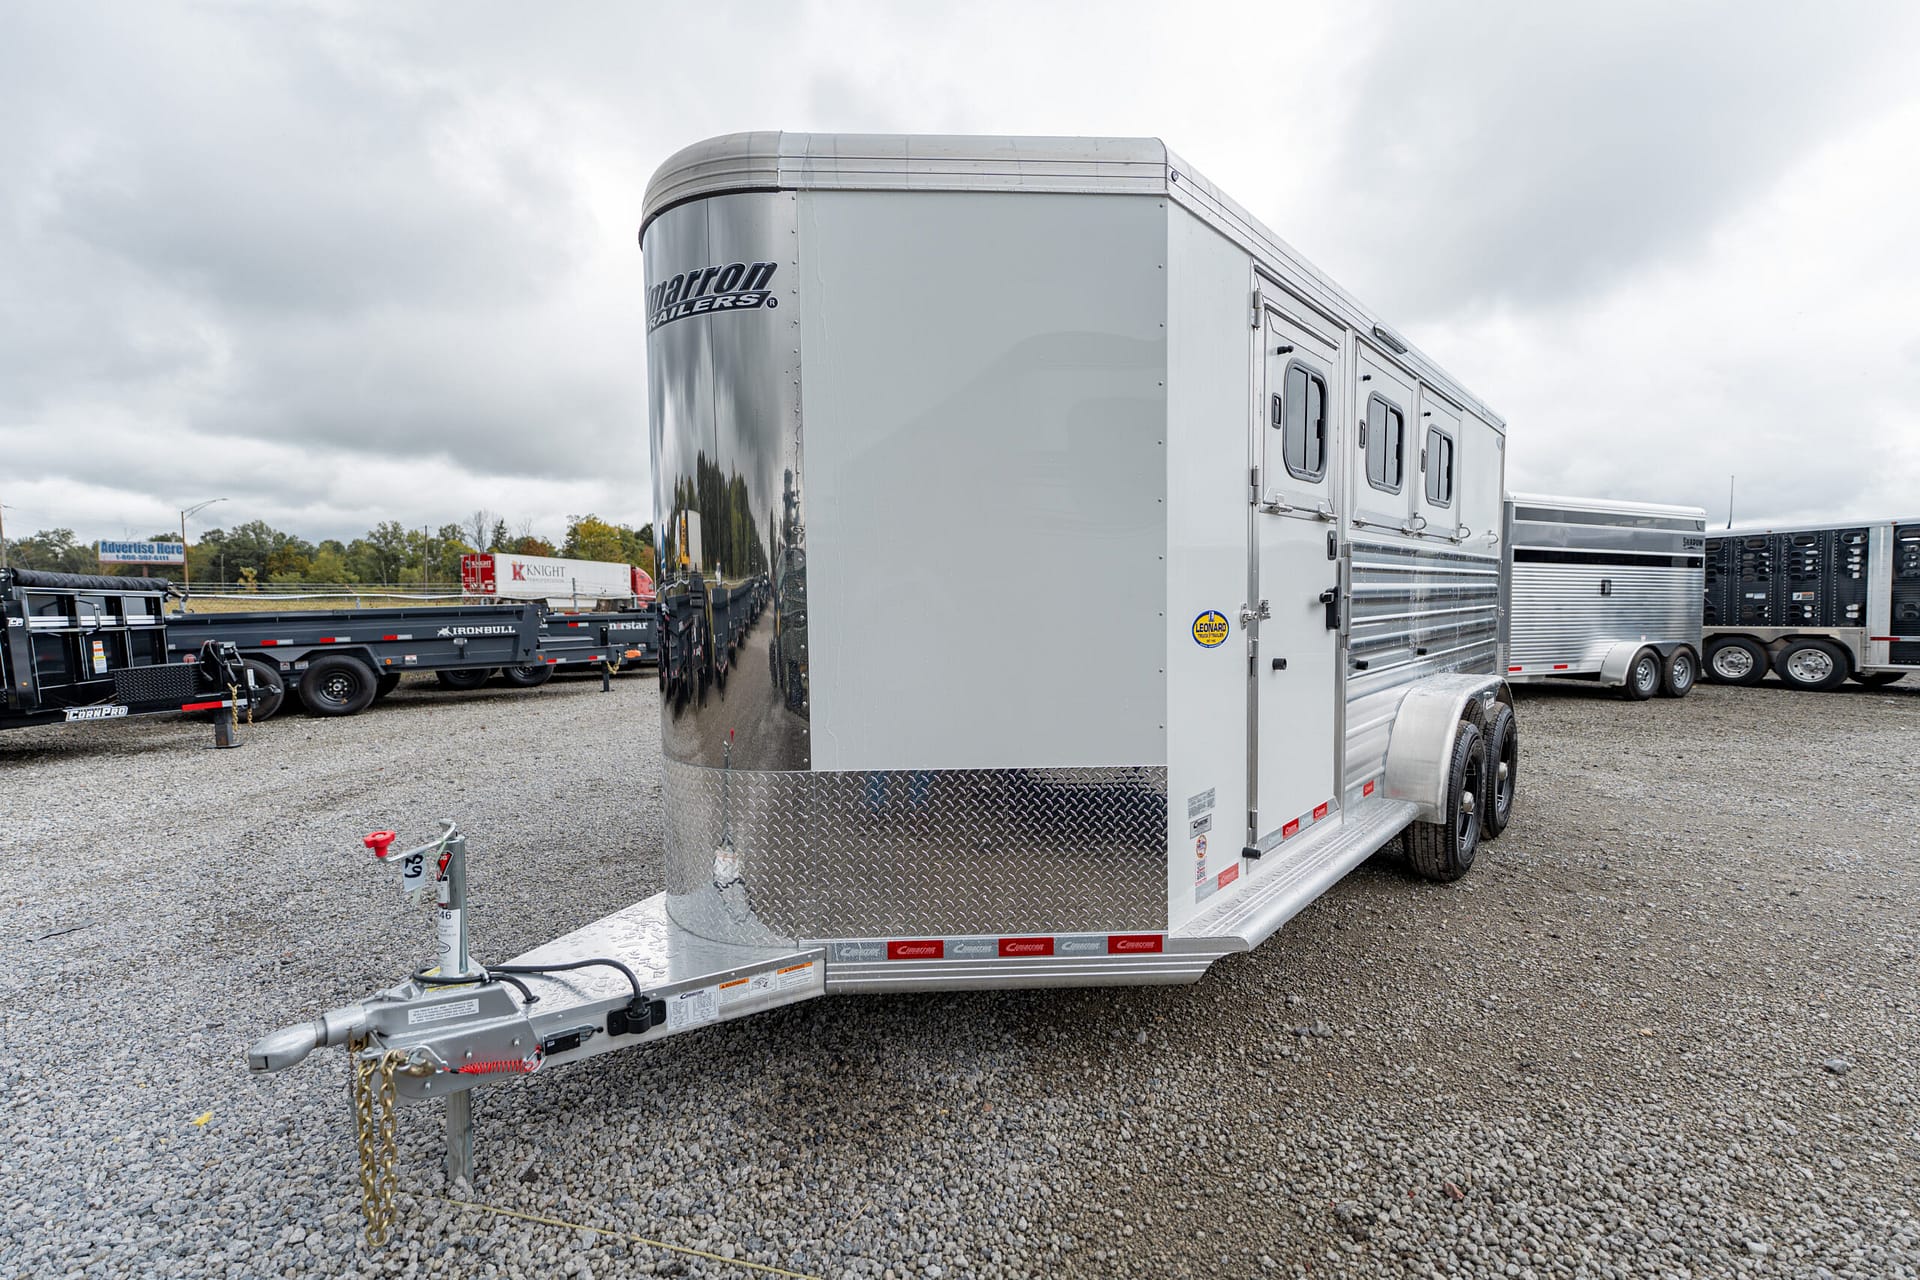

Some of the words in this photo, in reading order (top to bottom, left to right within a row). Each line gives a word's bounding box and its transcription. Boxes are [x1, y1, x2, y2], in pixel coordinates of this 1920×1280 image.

[648, 262, 778, 317] marron
[648, 293, 761, 331] RAILERS
[101, 541, 155, 554] Advertise
[157, 542, 183, 555] Here
[527, 563, 566, 578] KNIGHT
[453, 625, 516, 635] IRONBULL
[1195, 622, 1227, 633] LEONARD
